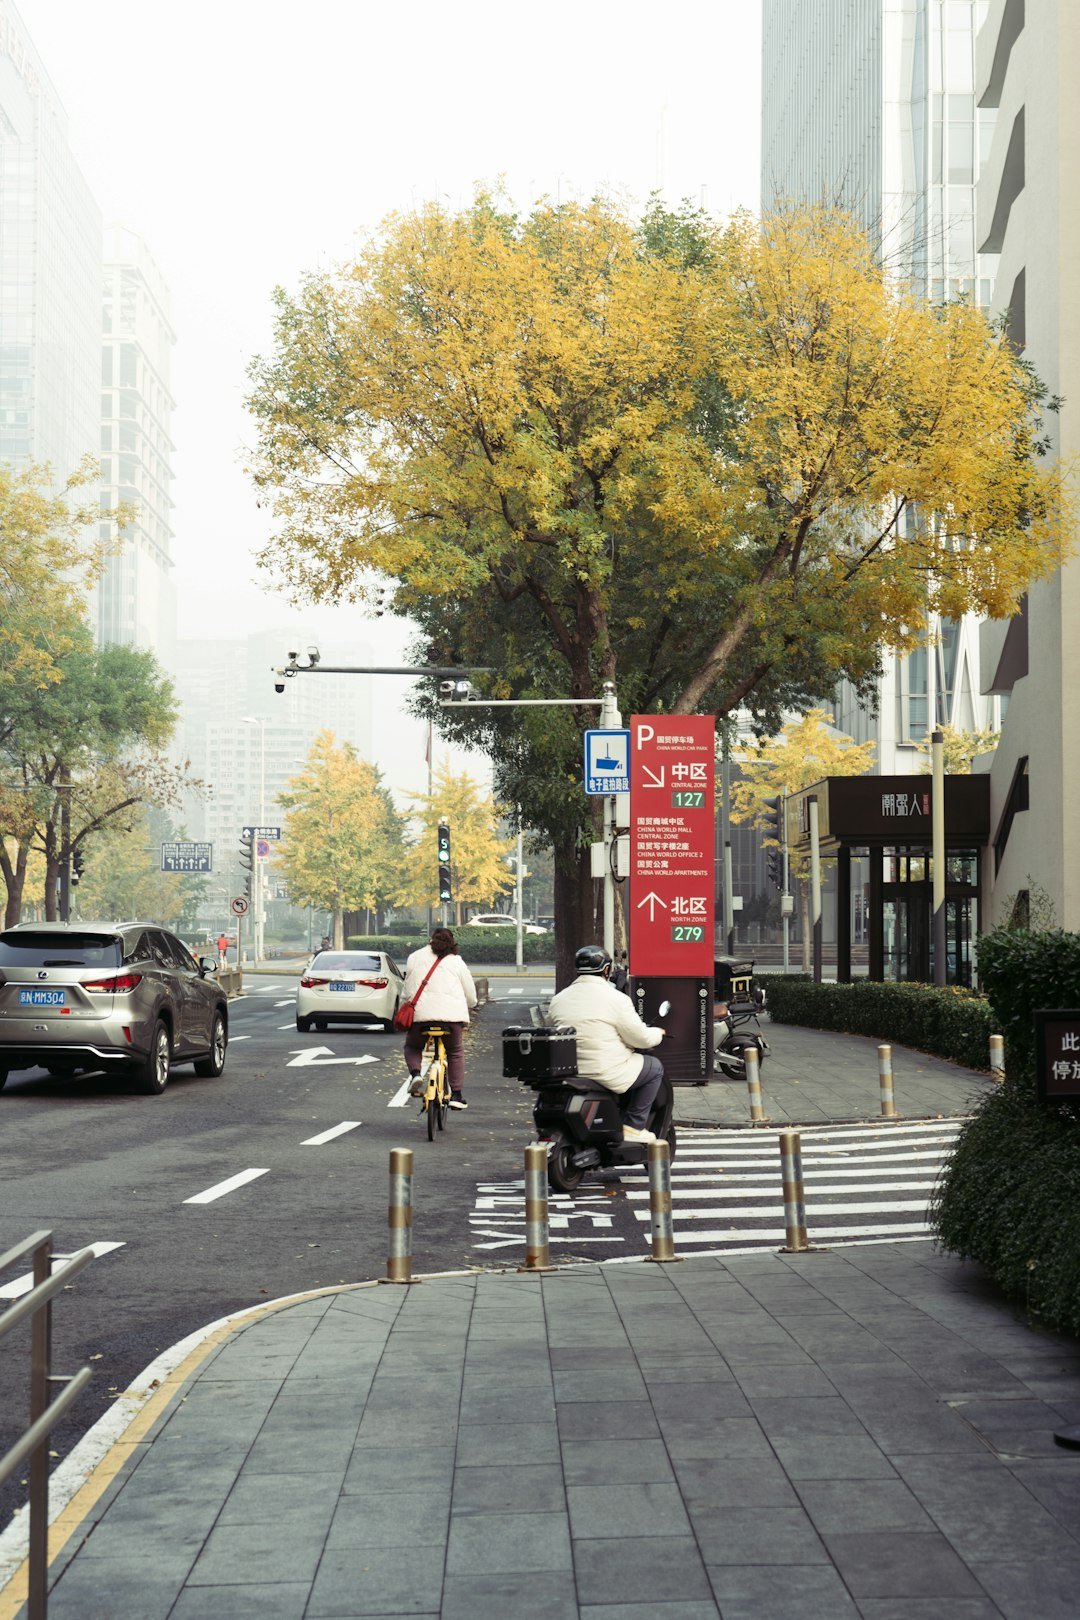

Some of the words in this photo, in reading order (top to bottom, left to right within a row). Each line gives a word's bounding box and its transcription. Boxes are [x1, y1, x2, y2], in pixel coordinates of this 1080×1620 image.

[637, 724, 655, 750] P
[656, 735, 695, 744] 国贸停车场
[671, 762, 708, 781] 中区
[675, 792, 703, 807] 127
[637, 817, 685, 826] 国贸商城中区
[637, 842, 690, 850] 国贸写字楼2座
[637, 860, 669, 868] 国贸公寓
[670, 896, 707, 915] 北区
[674, 926, 702, 941] 279
